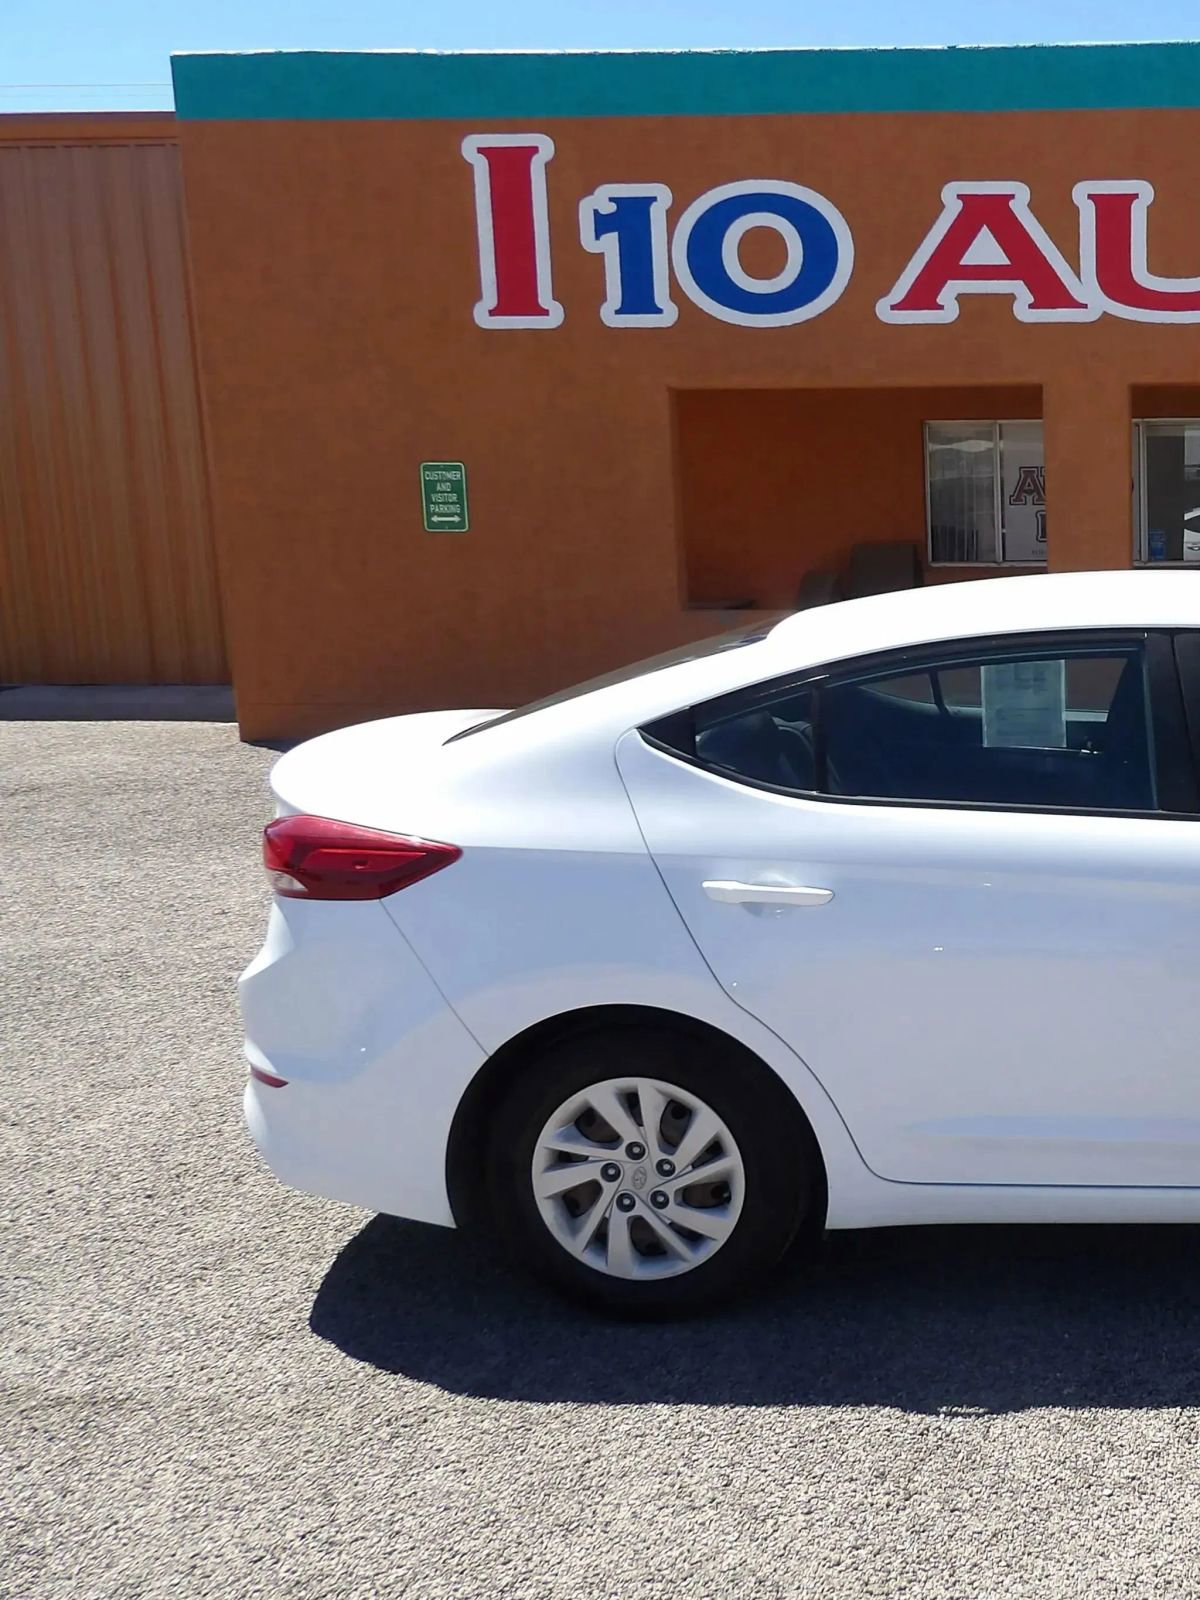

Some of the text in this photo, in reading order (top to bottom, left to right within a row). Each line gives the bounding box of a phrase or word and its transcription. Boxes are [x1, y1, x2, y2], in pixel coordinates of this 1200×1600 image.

[425, 471, 462, 480] CUSTOMER
[436, 482, 451, 491] AND
[431, 493, 458, 502] VISITOR
[430, 504, 461, 513] PARKING
